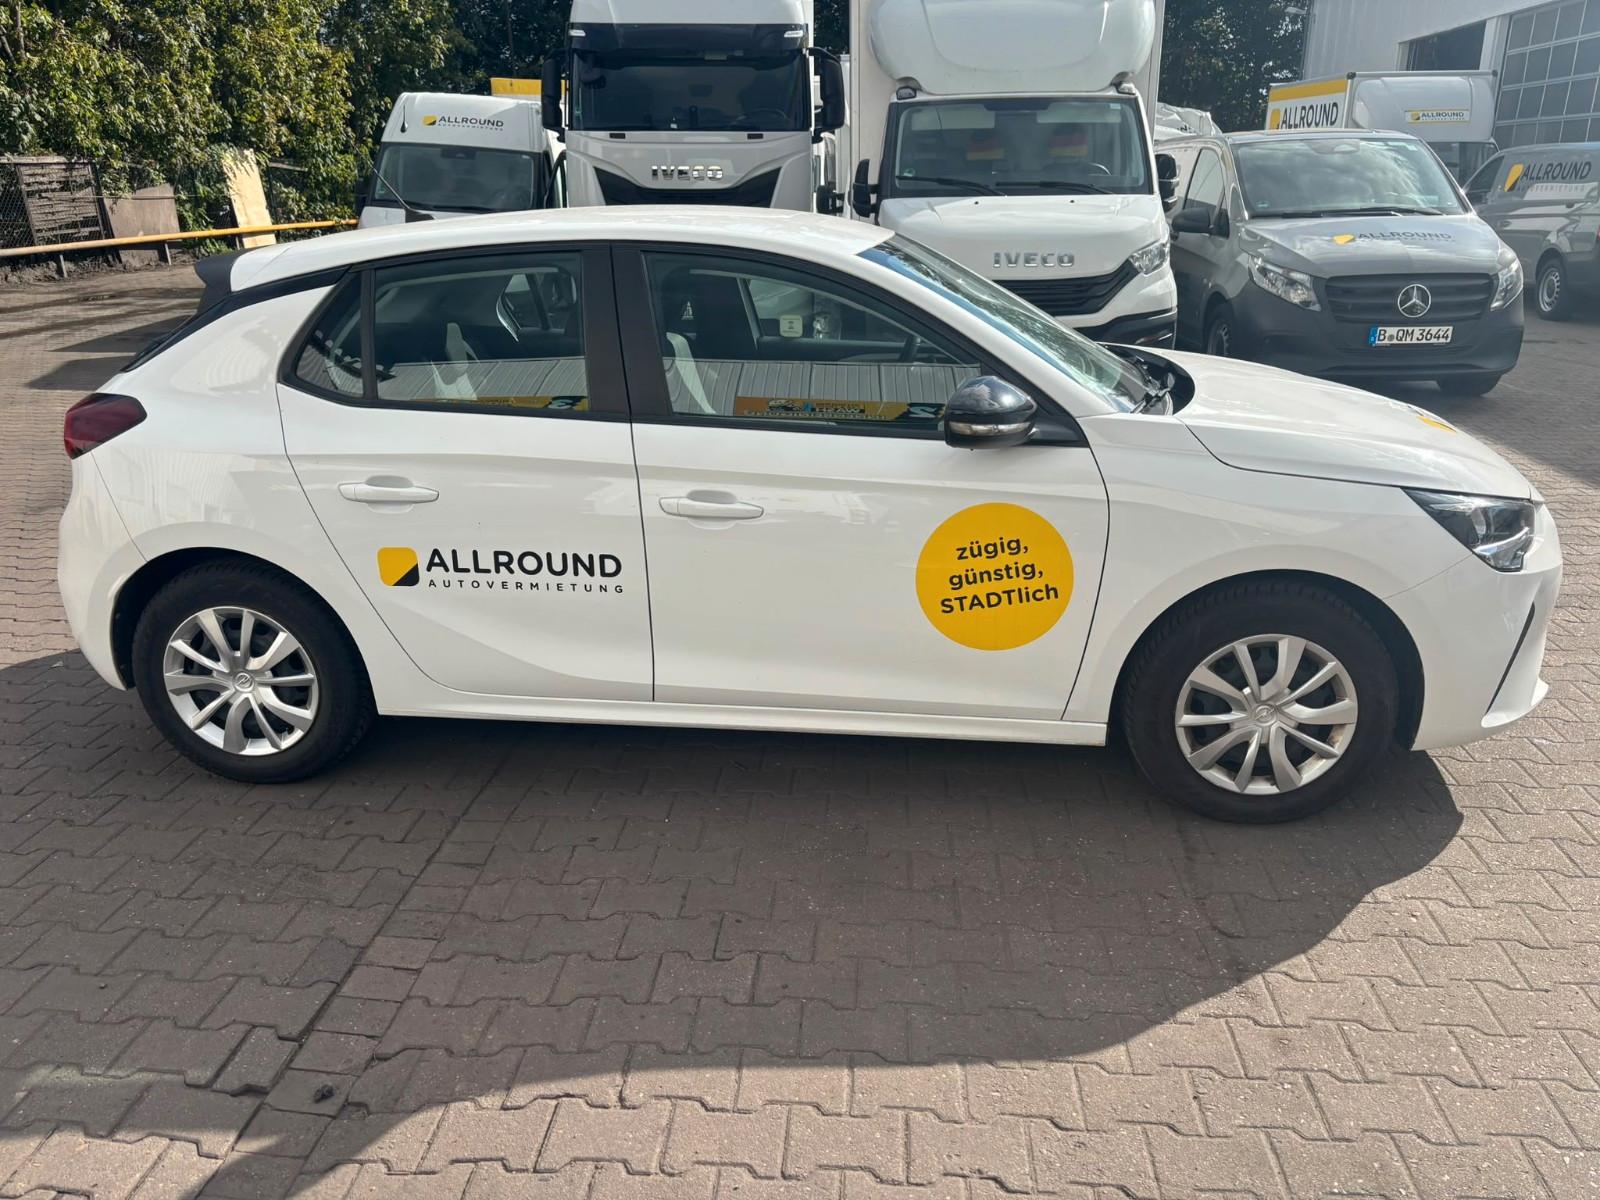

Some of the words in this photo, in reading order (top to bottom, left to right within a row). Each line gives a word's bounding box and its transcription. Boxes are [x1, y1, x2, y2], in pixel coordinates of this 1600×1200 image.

[438, 115, 504, 127] ALLROUND
[1281, 102, 1339, 129] ALLROUND
[651, 165, 723, 181] IVECO
[1520, 161, 1592, 180] ALLROUND
[1358, 231, 1452, 240] ALLROUND
[993, 252, 1075, 268] IVECO
[956, 537, 1028, 560] zügig,
[426, 548, 622, 578] ALLROUND
[949, 562, 1043, 590] günstig,
[428, 579, 623, 594] AUTOVERMIETUNG
[940, 584, 1059, 614] STADTlich
